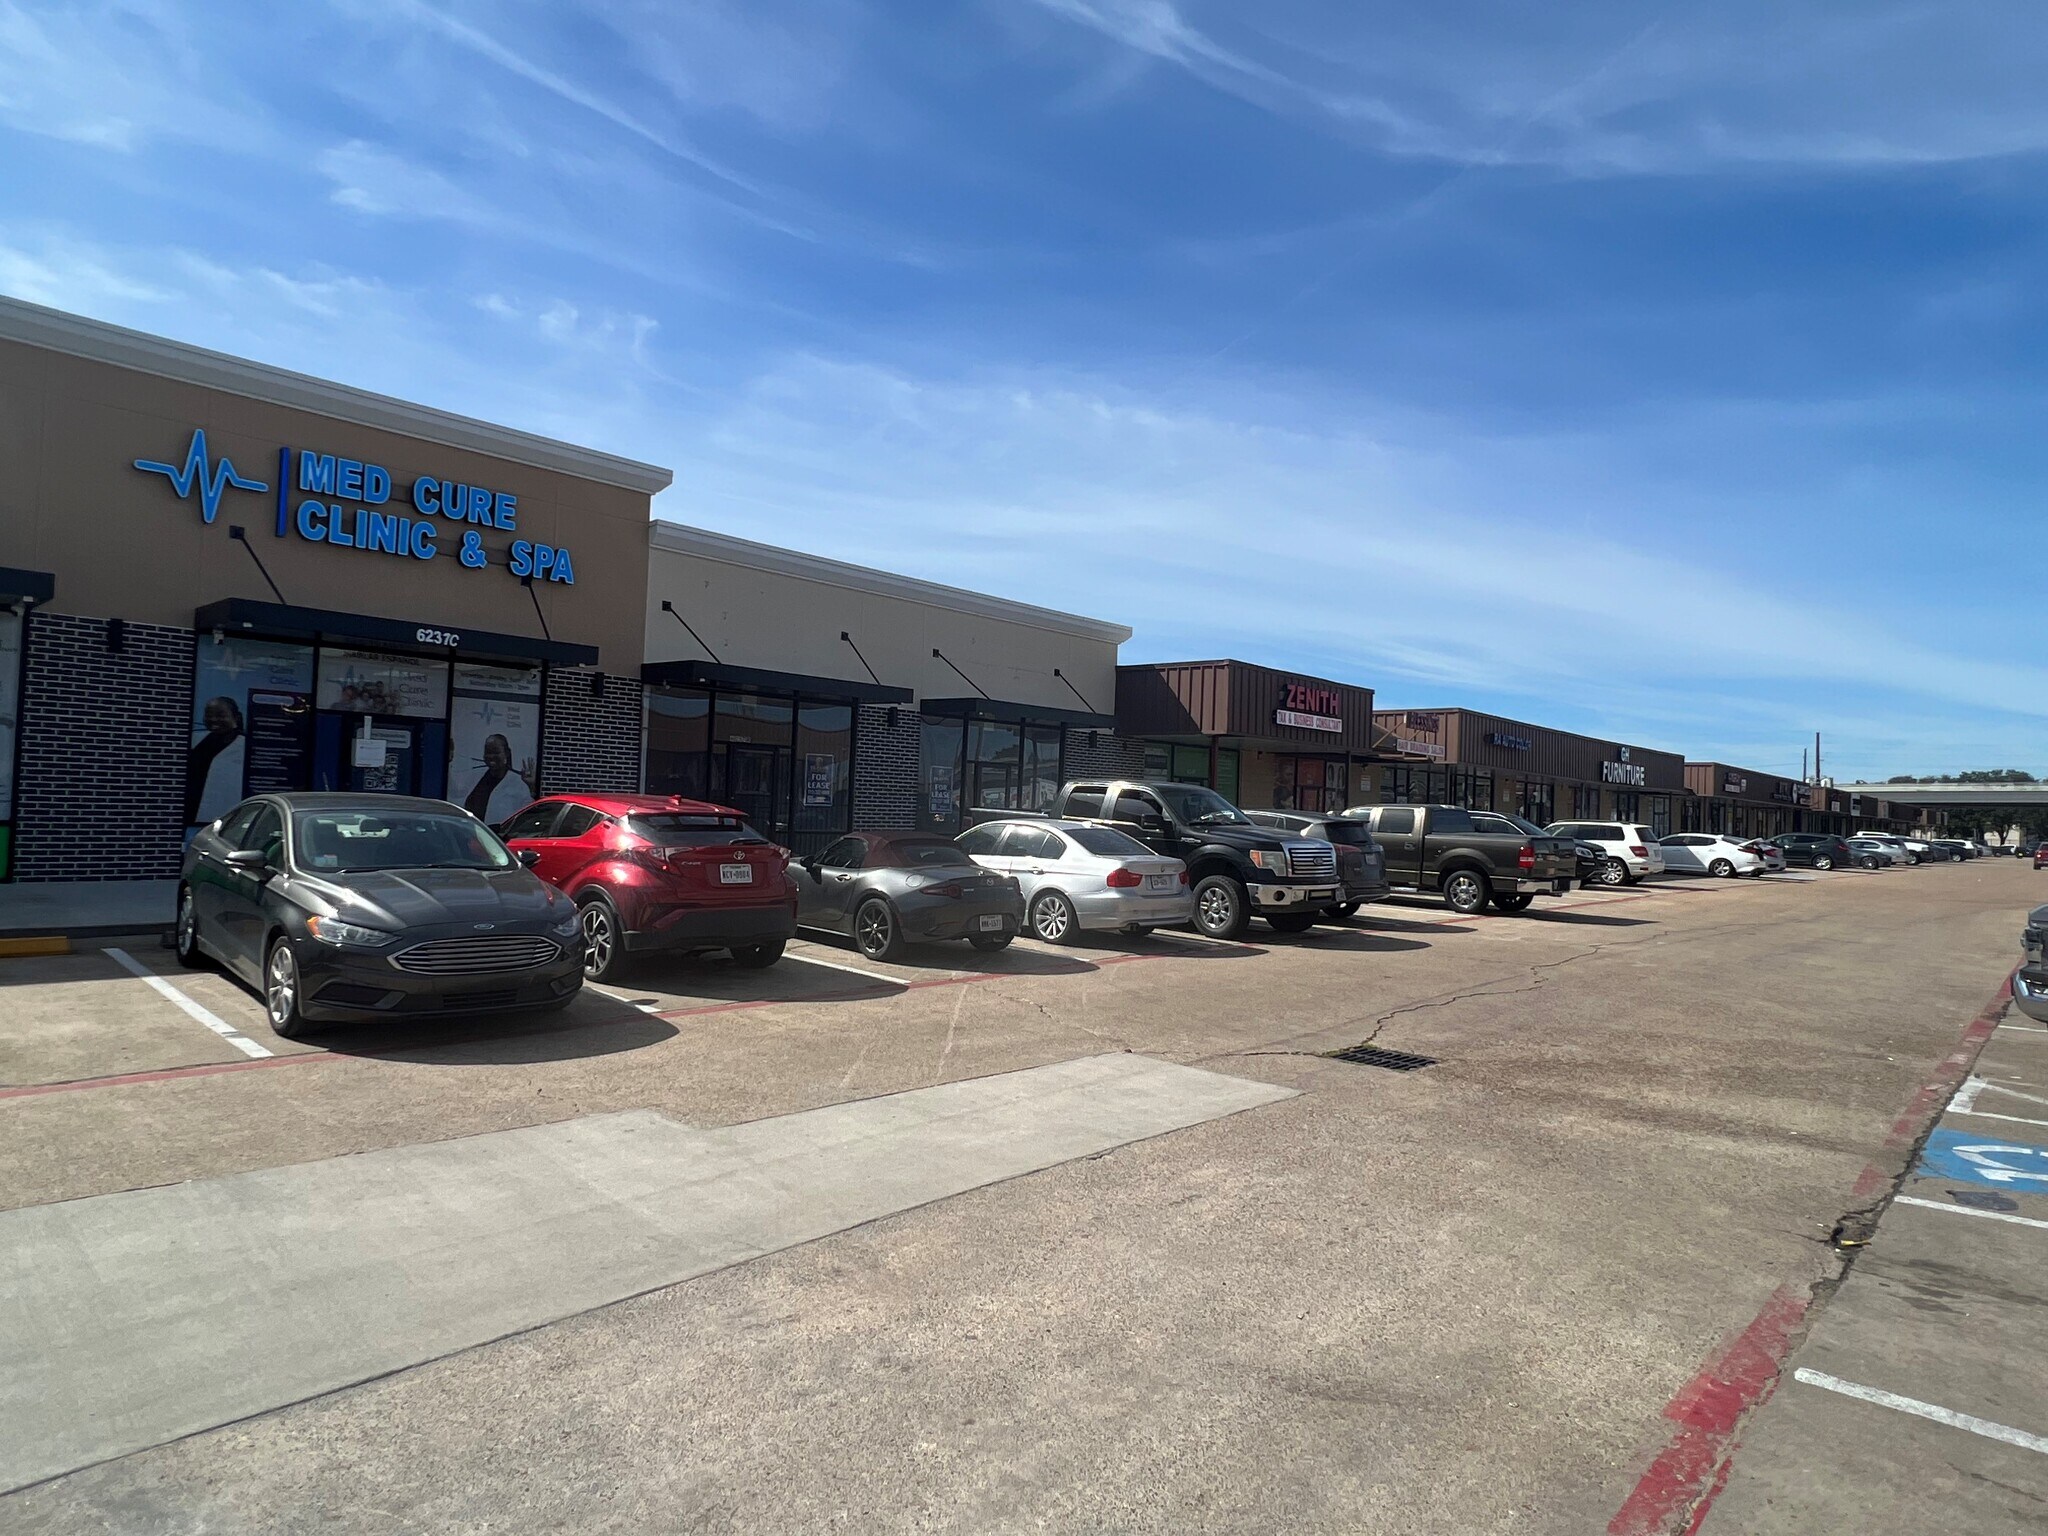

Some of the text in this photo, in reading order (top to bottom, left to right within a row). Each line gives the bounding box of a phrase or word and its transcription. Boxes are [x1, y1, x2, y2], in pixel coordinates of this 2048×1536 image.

[300, 450, 517, 531] MED CURE
[297, 500, 574, 584] CLINIC & SPA
[416, 628, 459, 647] 6237C
[1286, 684, 1339, 715] ZENITH
[1293, 714, 1314, 727] BUSINESS
[1316, 717, 1341, 731] CONSULTANT
[812, 773, 827, 781] FOR
[1602, 761, 1645, 786] FURNITURE
[808, 781, 830, 789] LEASE
